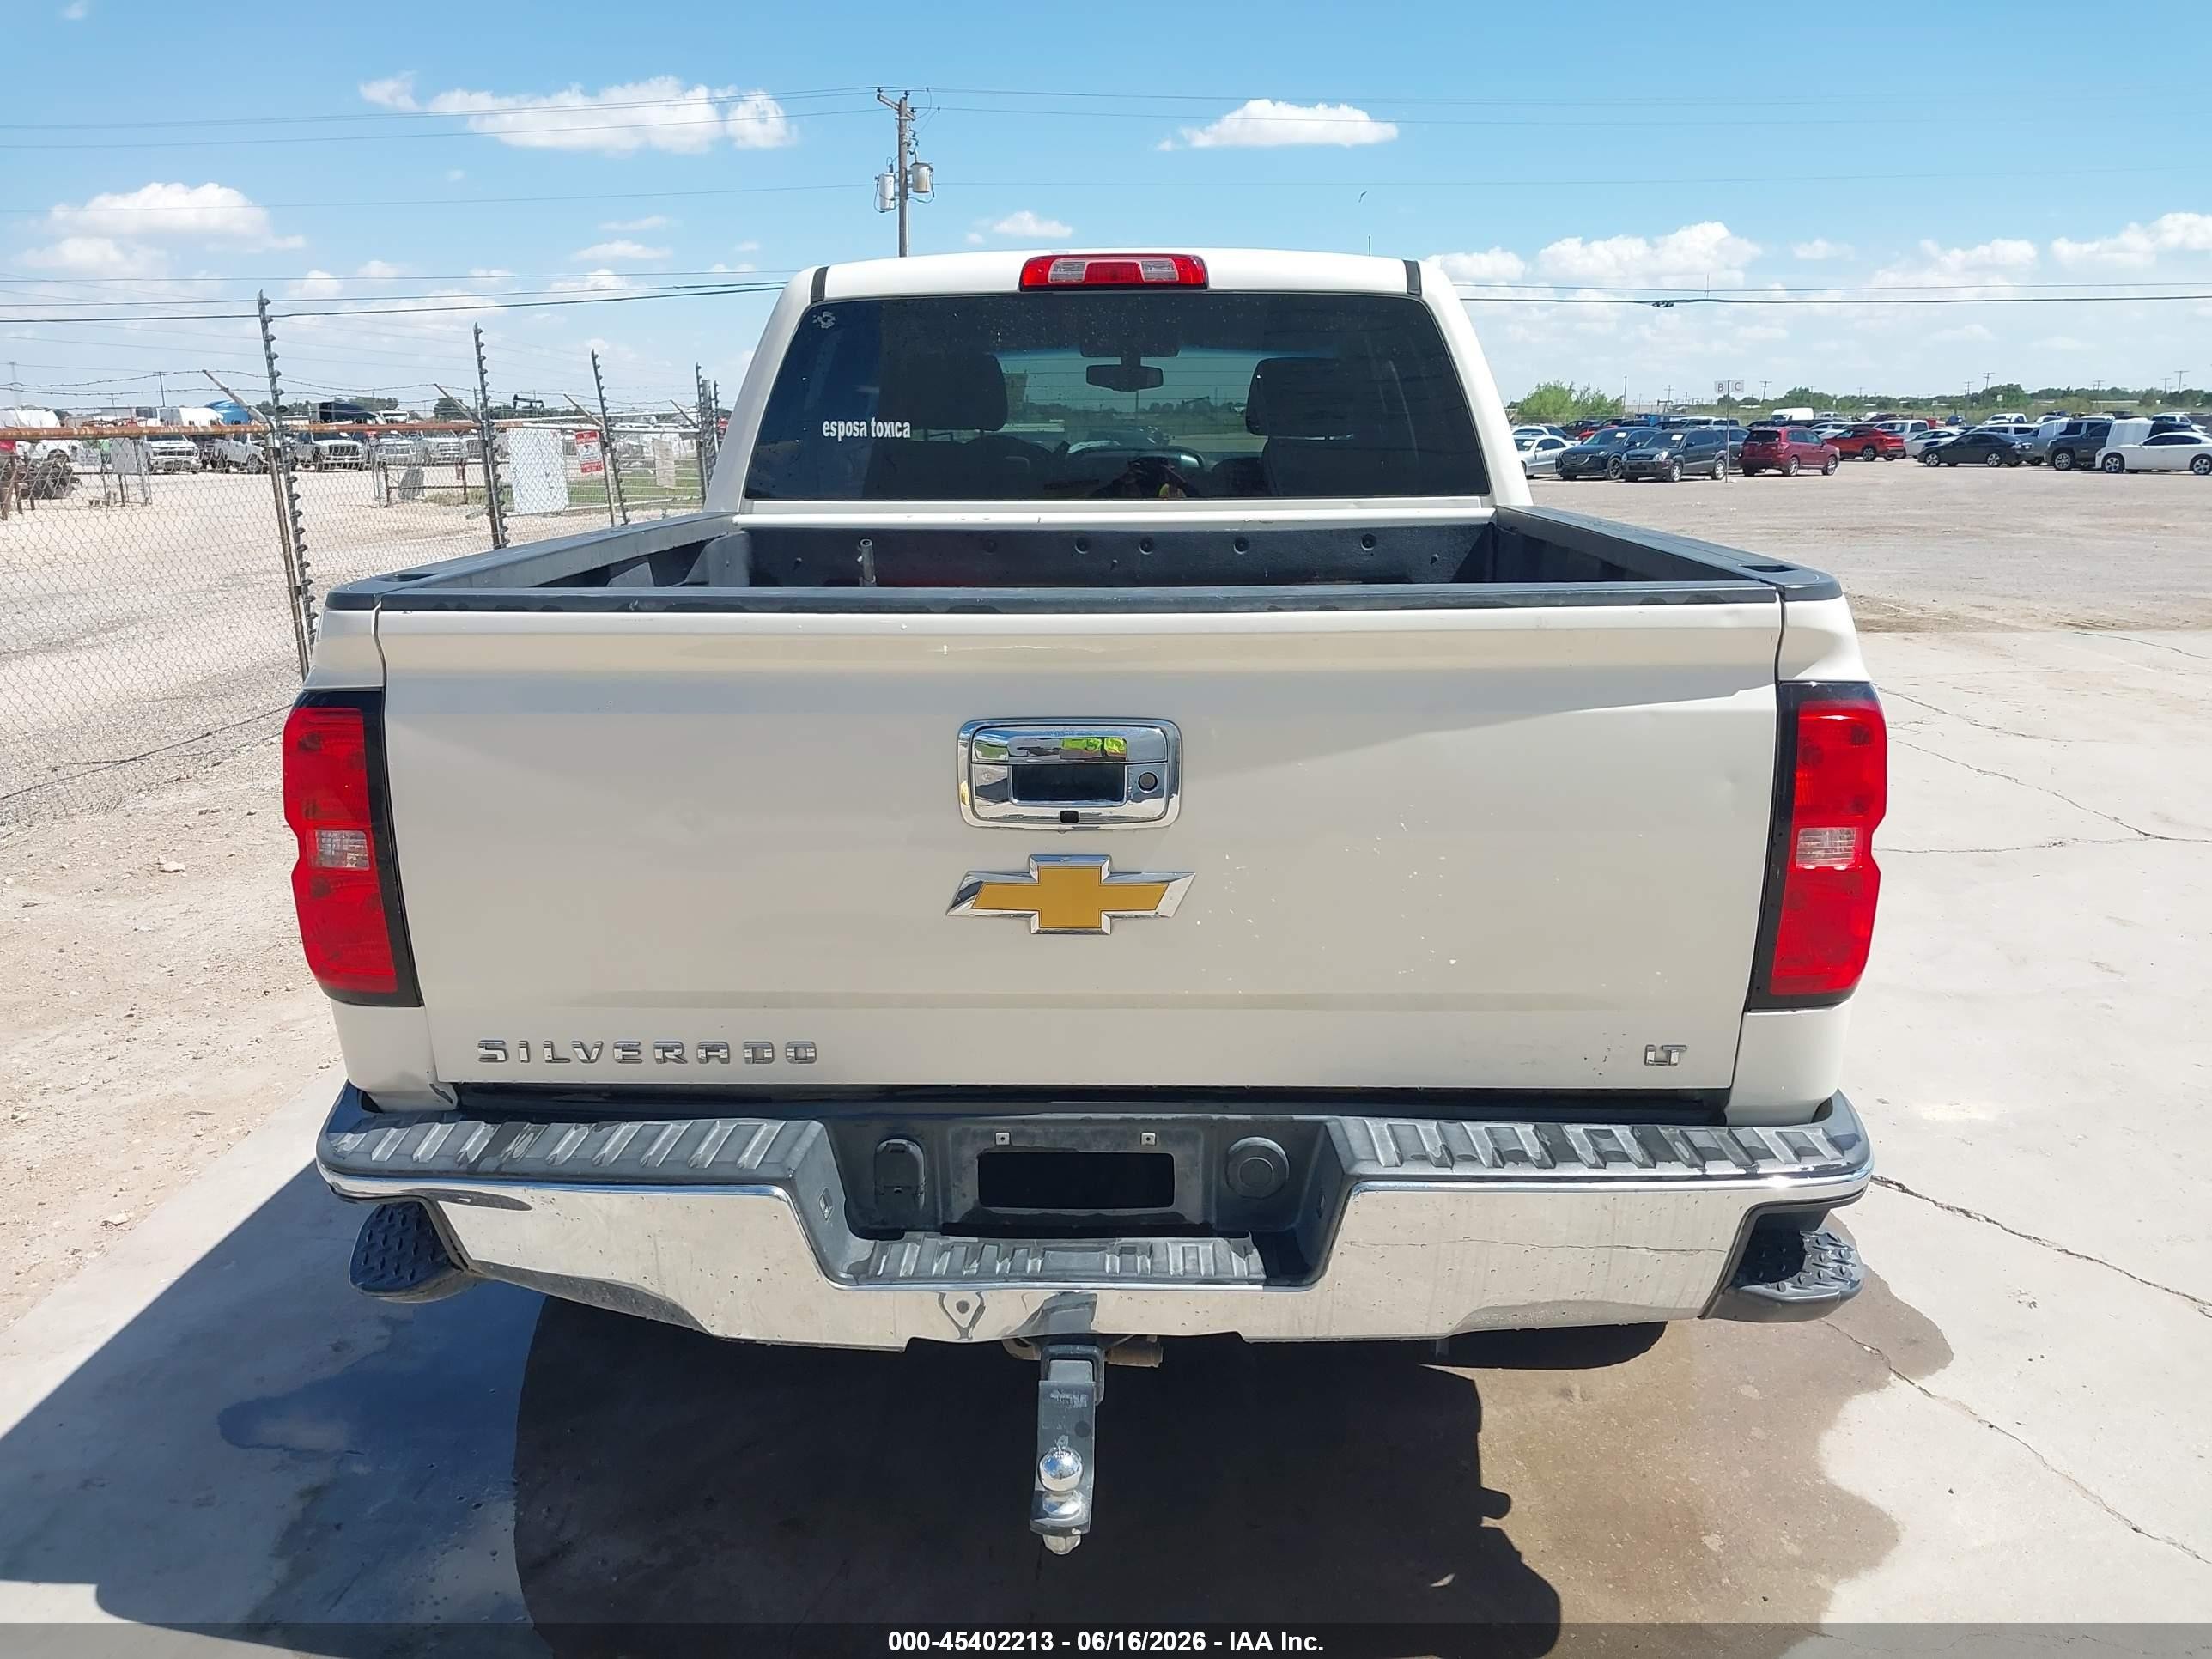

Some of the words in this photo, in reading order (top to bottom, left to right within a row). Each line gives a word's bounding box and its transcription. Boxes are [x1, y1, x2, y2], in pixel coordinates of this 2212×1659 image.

[1717, 383, 1724, 392] B
[1734, 382, 1741, 392] C
[822, 420, 868, 442] esposa
[870, 416, 911, 439] toxica
[477, 1039, 818, 1065] SILVERADO
[1644, 1044, 1688, 1066] LT
